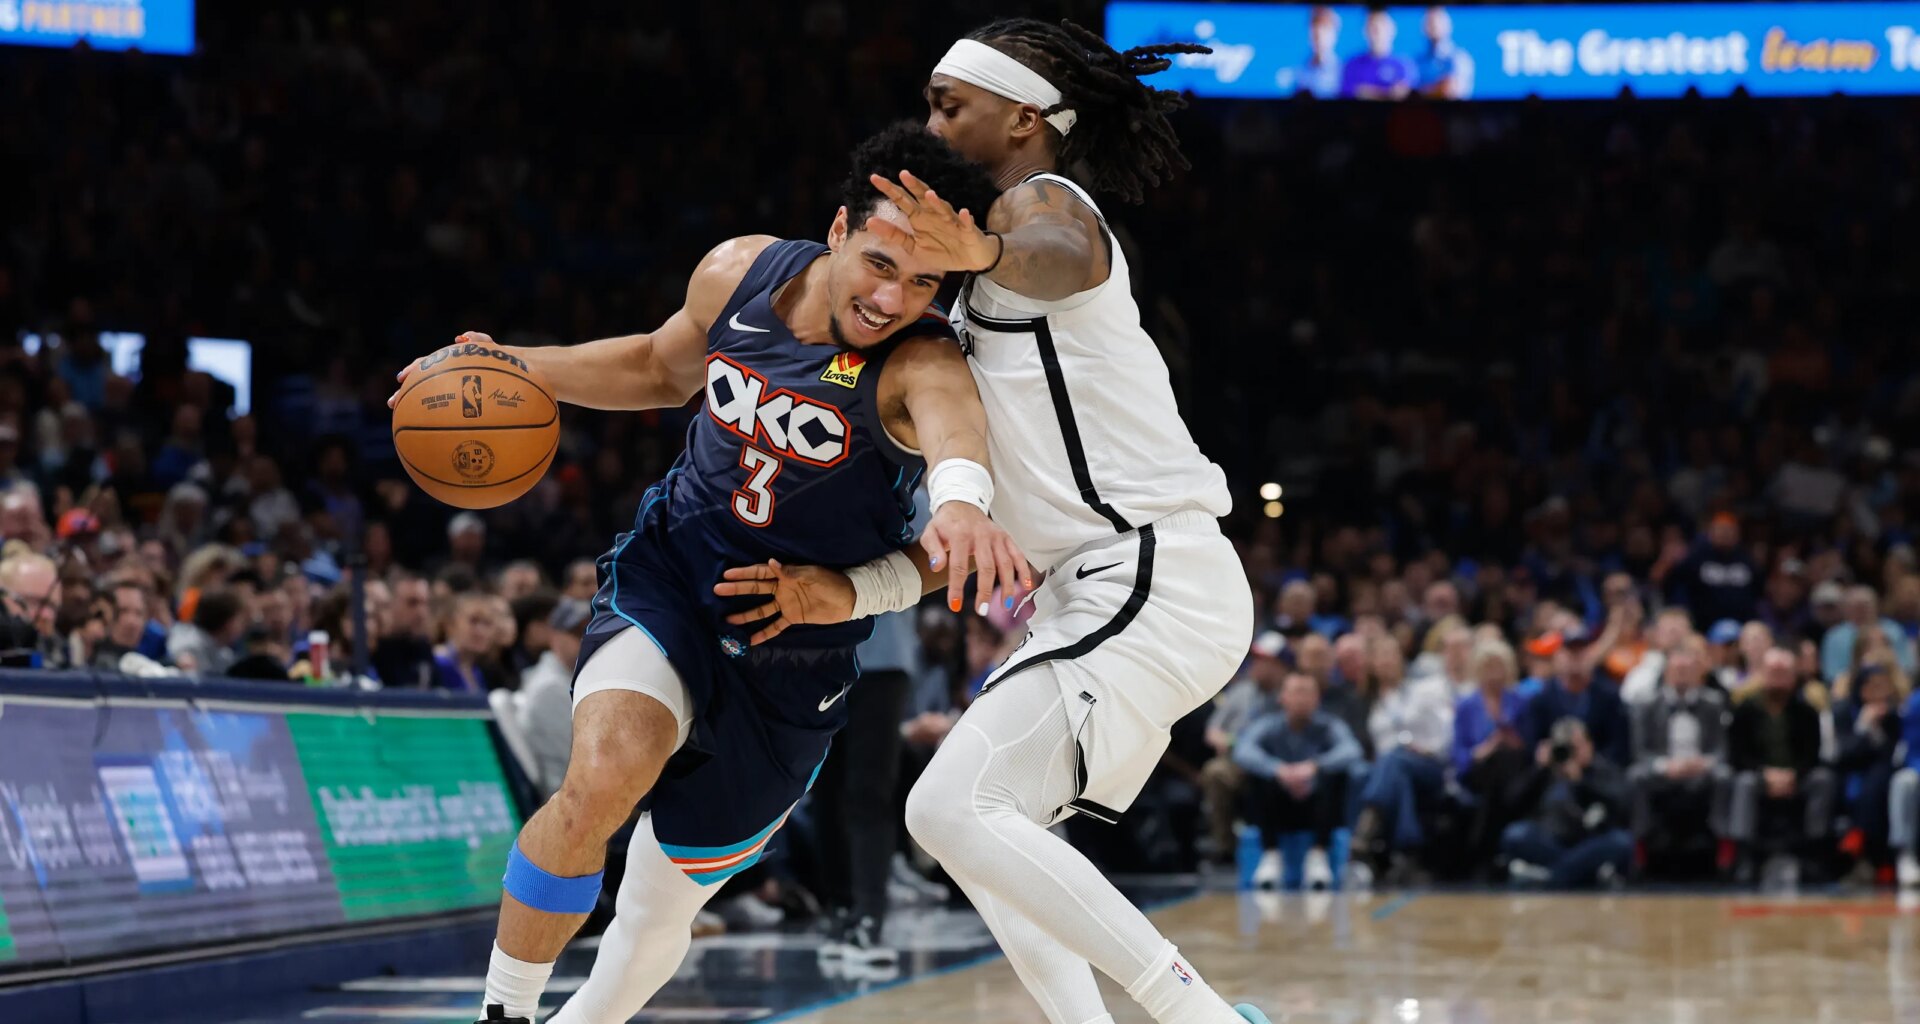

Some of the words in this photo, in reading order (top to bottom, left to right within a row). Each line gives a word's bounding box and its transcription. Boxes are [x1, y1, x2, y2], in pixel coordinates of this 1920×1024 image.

[1498, 29, 1574, 76] The
[1577, 29, 1748, 76] Greatest
[420, 344, 528, 374] Wilson
[706, 353, 851, 467] OKC
[732, 444, 782, 527] 3
